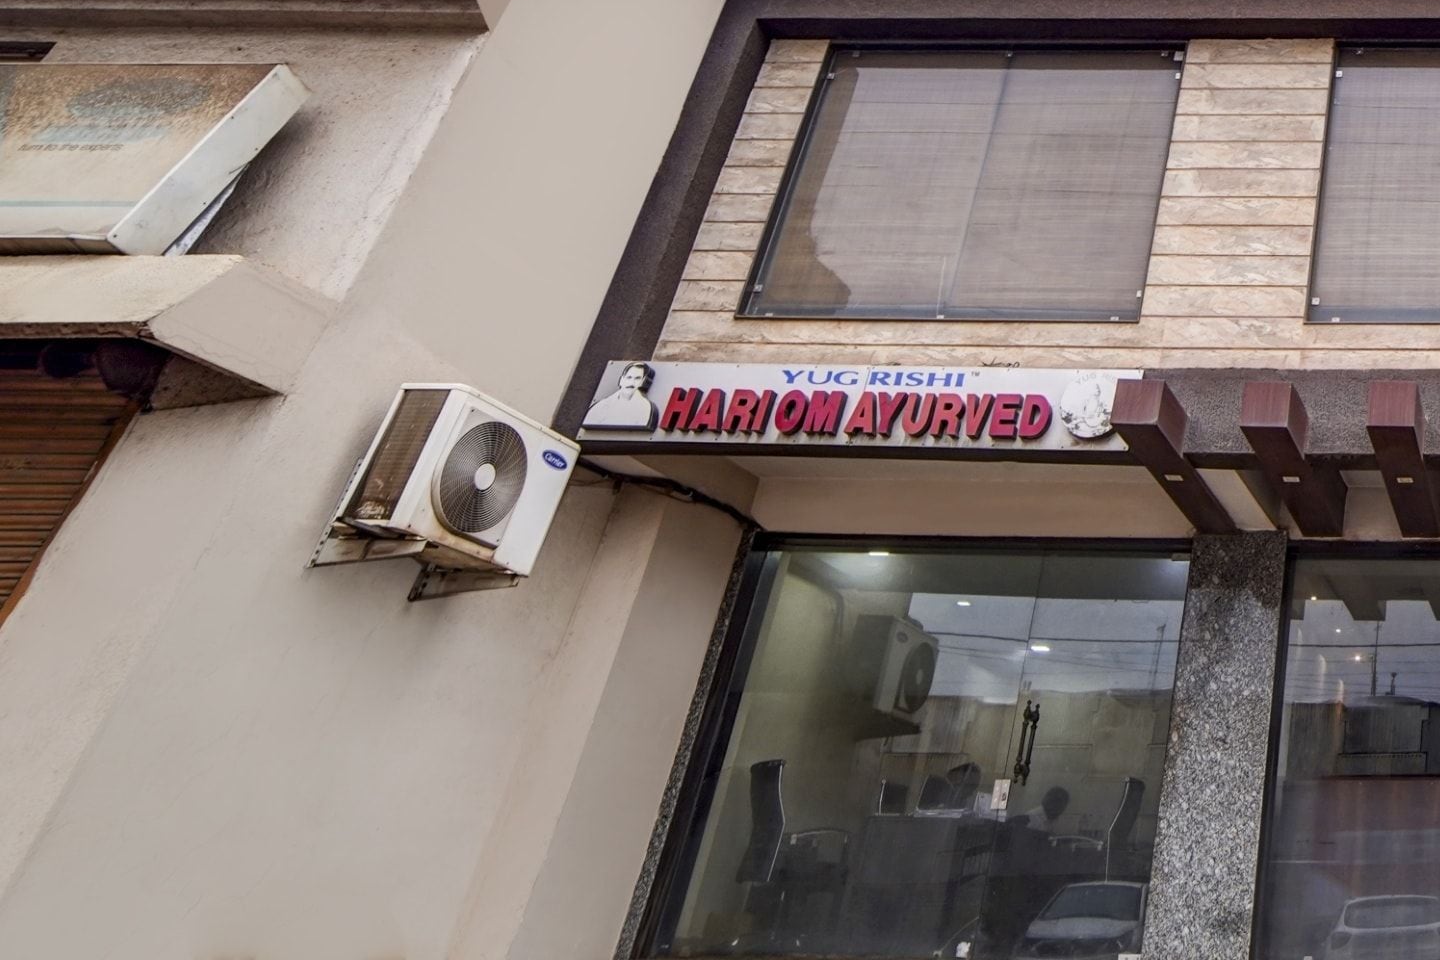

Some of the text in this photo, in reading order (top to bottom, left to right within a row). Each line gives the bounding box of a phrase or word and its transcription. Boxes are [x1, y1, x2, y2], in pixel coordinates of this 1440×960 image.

[782, 370, 859, 385] YUG
[868, 371, 966, 388] RISHI
[660, 387, 1054, 441] HARI OM AYURVED
